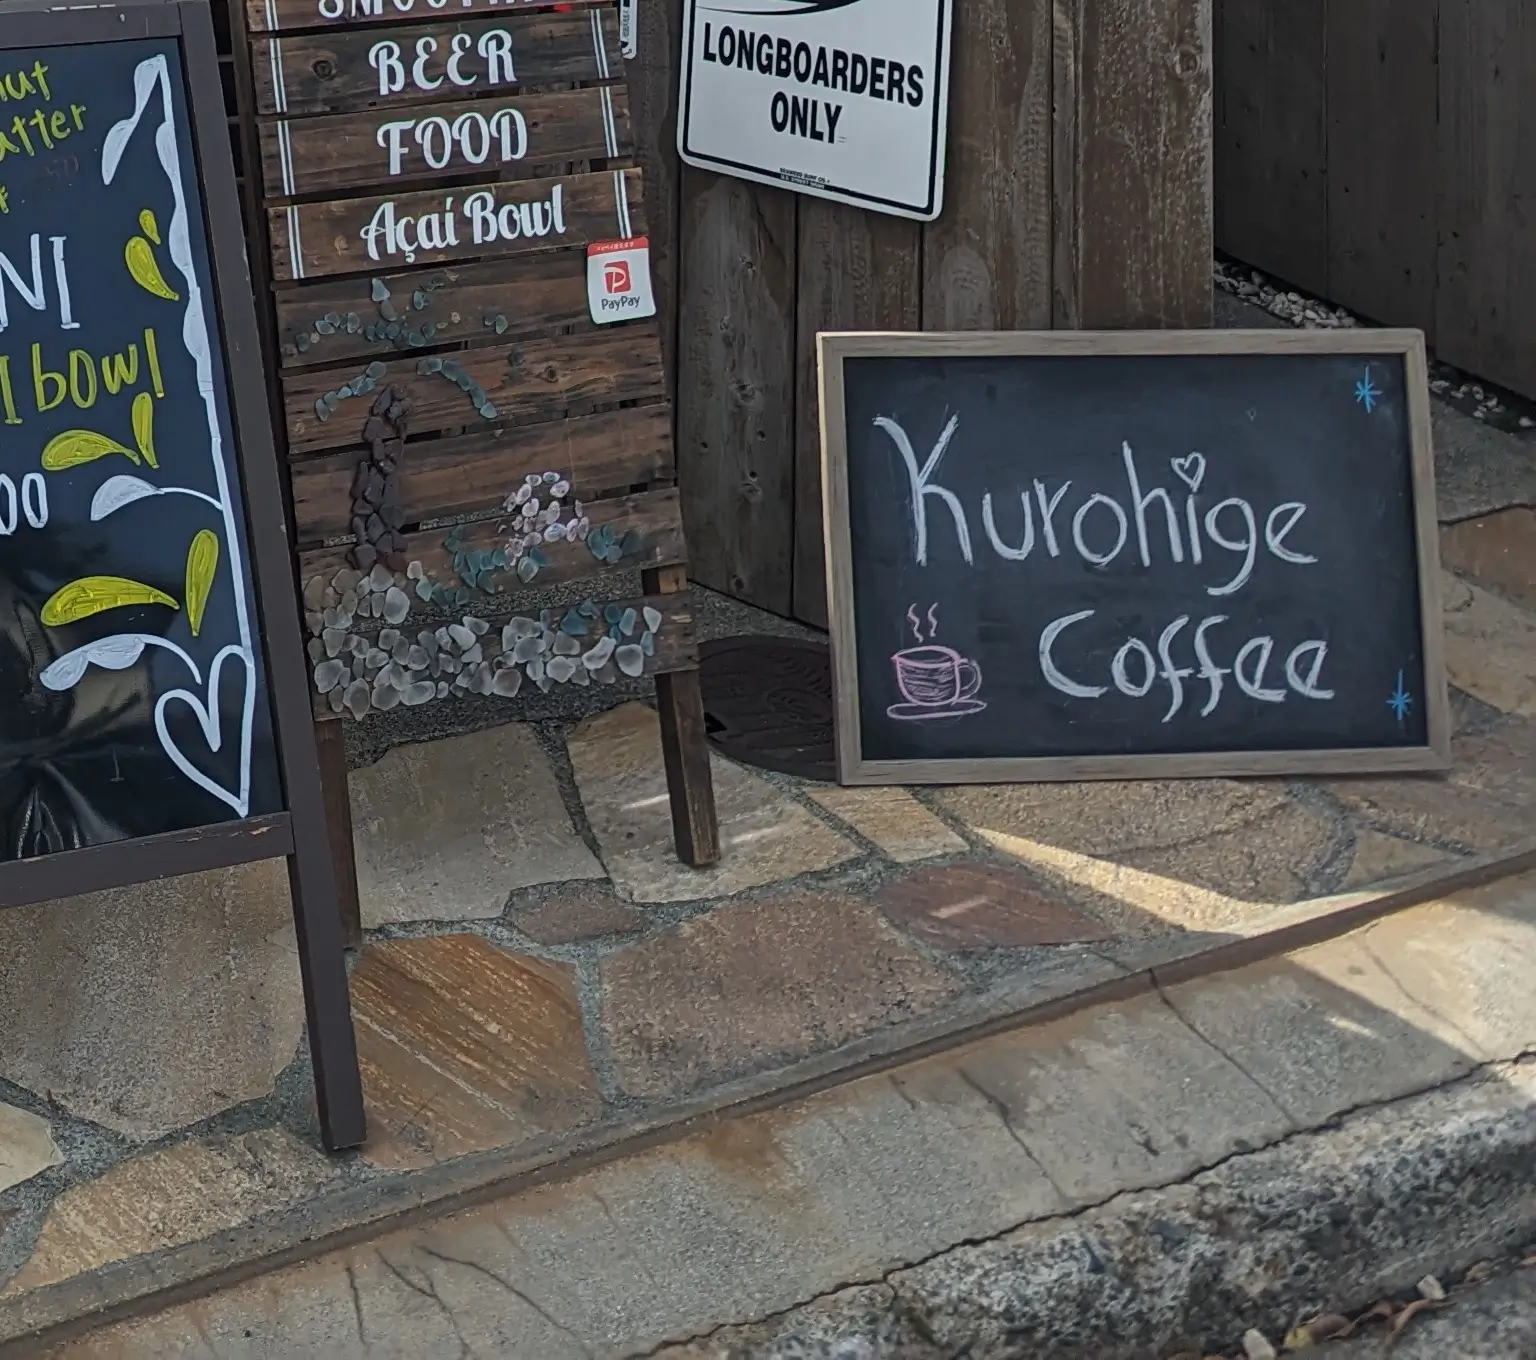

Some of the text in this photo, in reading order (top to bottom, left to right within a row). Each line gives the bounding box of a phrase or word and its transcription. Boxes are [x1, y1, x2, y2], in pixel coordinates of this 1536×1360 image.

[368, 27, 518, 97] BEER
[702, 22, 925, 108] LONGBOARDERS
[375, 107, 529, 176] FOOD
[770, 91, 843, 145] ONLY
[462, 183, 567, 242] Bowl
[600, 295, 641, 312] PayPay
[31, 327, 165, 412] bowl
[871, 405, 1320, 596] Kurohige
[1039, 608, 1335, 724] Coffee
